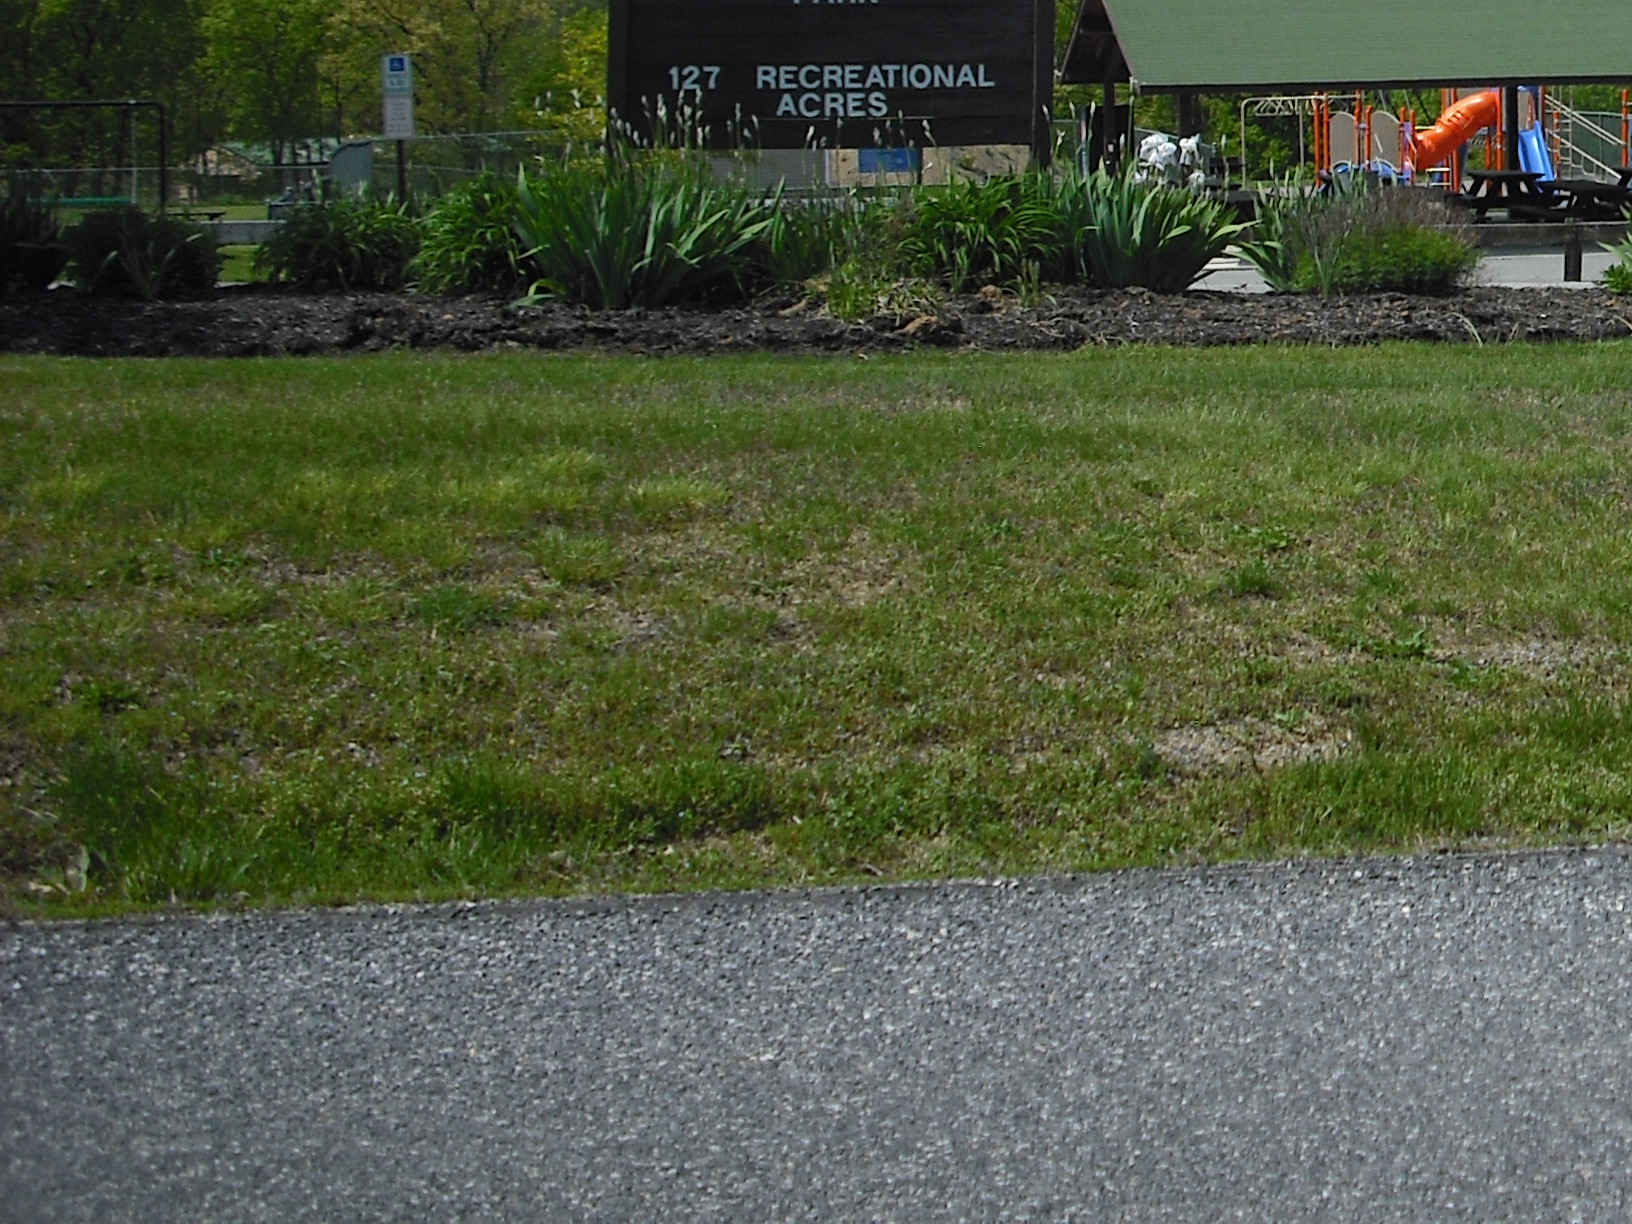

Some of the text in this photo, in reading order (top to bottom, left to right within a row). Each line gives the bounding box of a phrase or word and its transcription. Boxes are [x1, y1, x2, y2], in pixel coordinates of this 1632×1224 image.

[669, 63, 995, 91] 127 RECREATIONAL
[776, 91, 889, 118] ACRES
